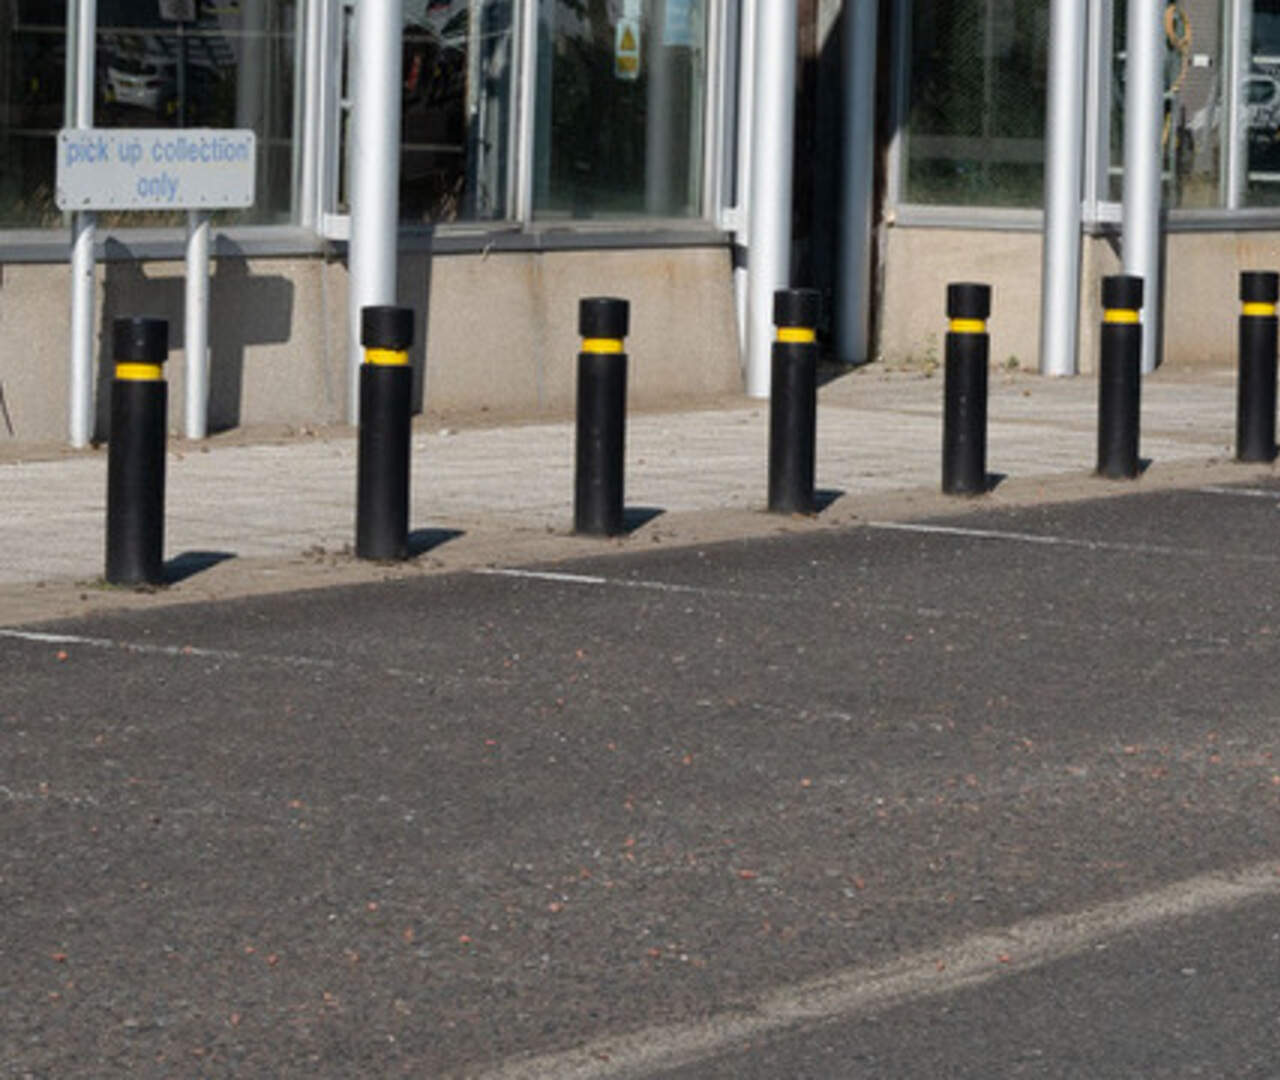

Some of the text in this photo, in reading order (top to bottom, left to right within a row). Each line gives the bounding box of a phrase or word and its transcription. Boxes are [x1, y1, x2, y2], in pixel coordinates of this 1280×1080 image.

[66, 137, 249, 166] pick up collection
[136, 172, 181, 201] only
